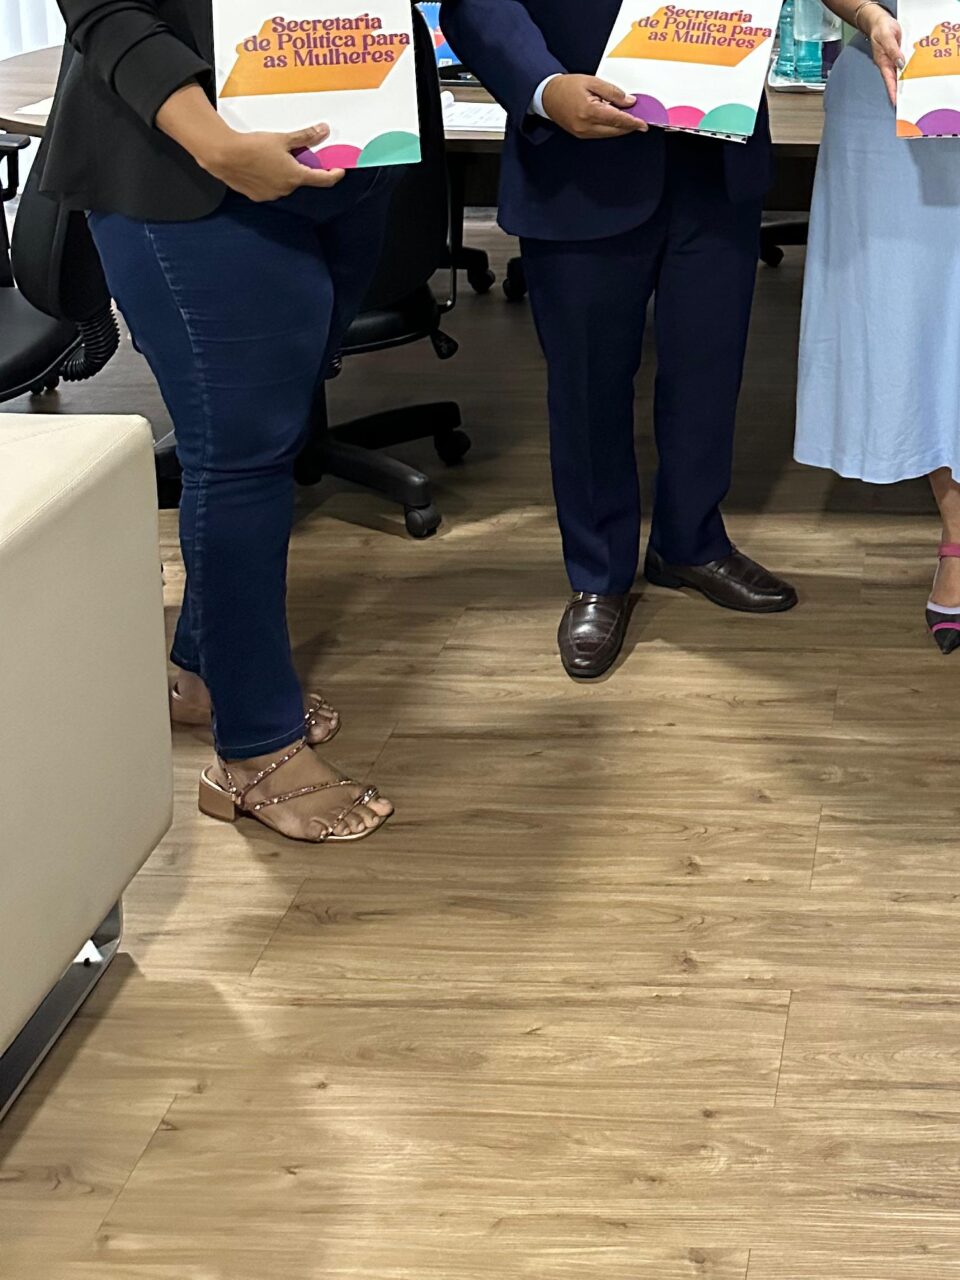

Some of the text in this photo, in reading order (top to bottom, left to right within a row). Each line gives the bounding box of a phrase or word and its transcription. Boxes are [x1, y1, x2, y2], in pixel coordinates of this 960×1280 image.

[272, 13, 382, 33] Secretaria
[663, 5, 753, 23] Secretaria
[638, 16, 660, 28] de
[731, 25, 772, 38] para
[243, 30, 410, 52] de Política para
[648, 29, 756, 49] as Mulheres
[919, 35, 940, 48] de
[263, 48, 395, 69] as Mulheres
[933, 48, 952, 59] as
